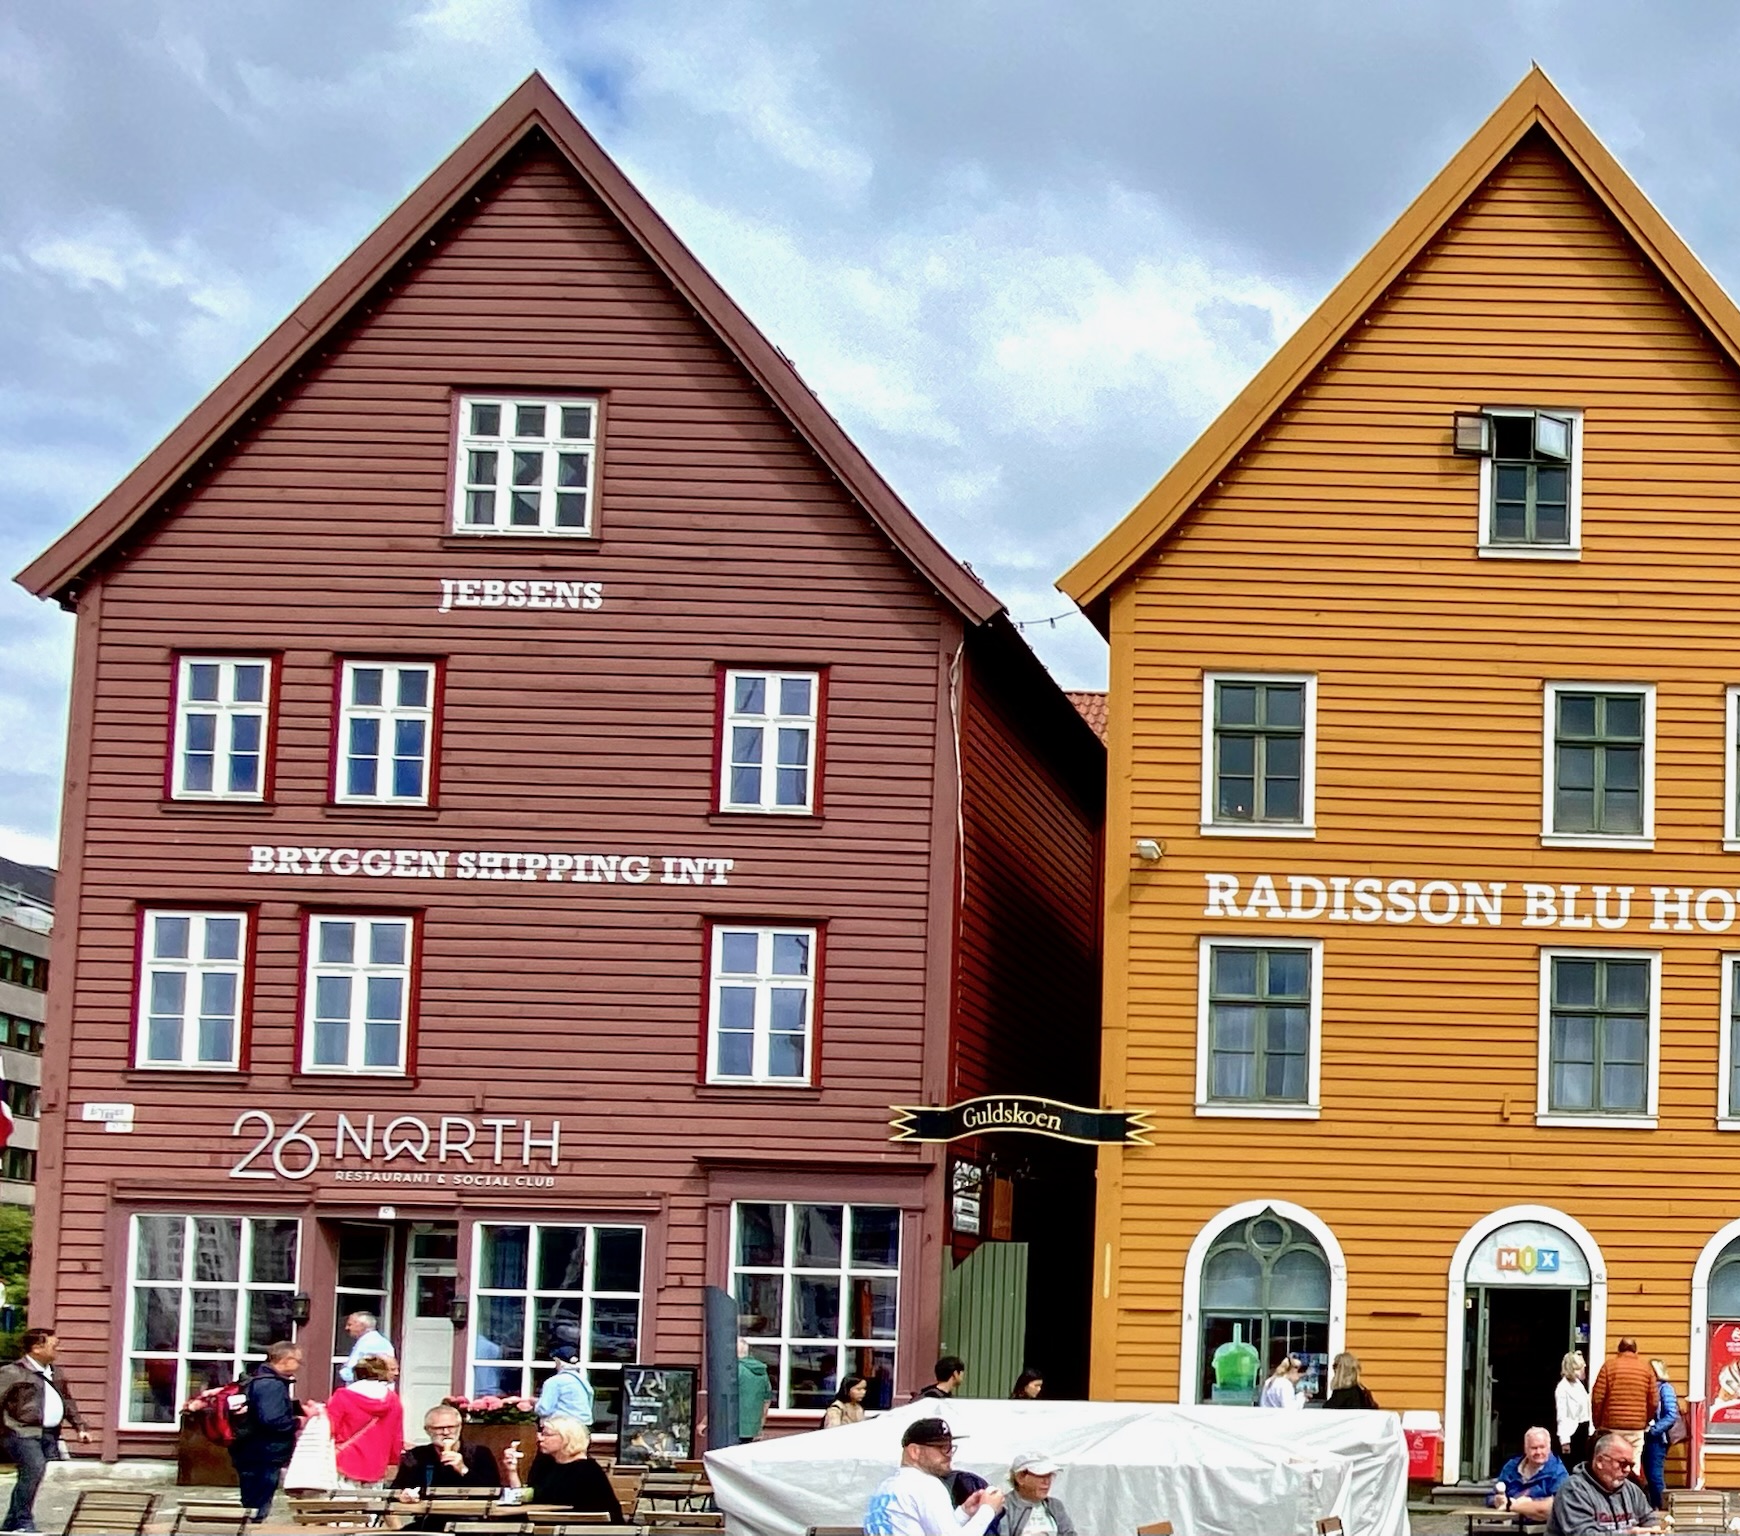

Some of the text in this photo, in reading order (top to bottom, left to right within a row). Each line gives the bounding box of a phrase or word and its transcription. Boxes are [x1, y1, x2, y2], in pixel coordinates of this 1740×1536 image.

[438, 579, 603, 613] JEBSENS
[248, 845, 735, 886] BRYGGEN SHIPPING INT
[1203, 872, 1508, 926] RADISSON
[1522, 882, 1636, 929] BLU
[962, 1102, 1062, 1131] Guldskoen
[228, 1109, 562, 1180] 26 NORTH
[334, 1170, 555, 1188] RESTAURANT & SOCIAL CLUB
[1500, 1250, 1556, 1268] MIX
